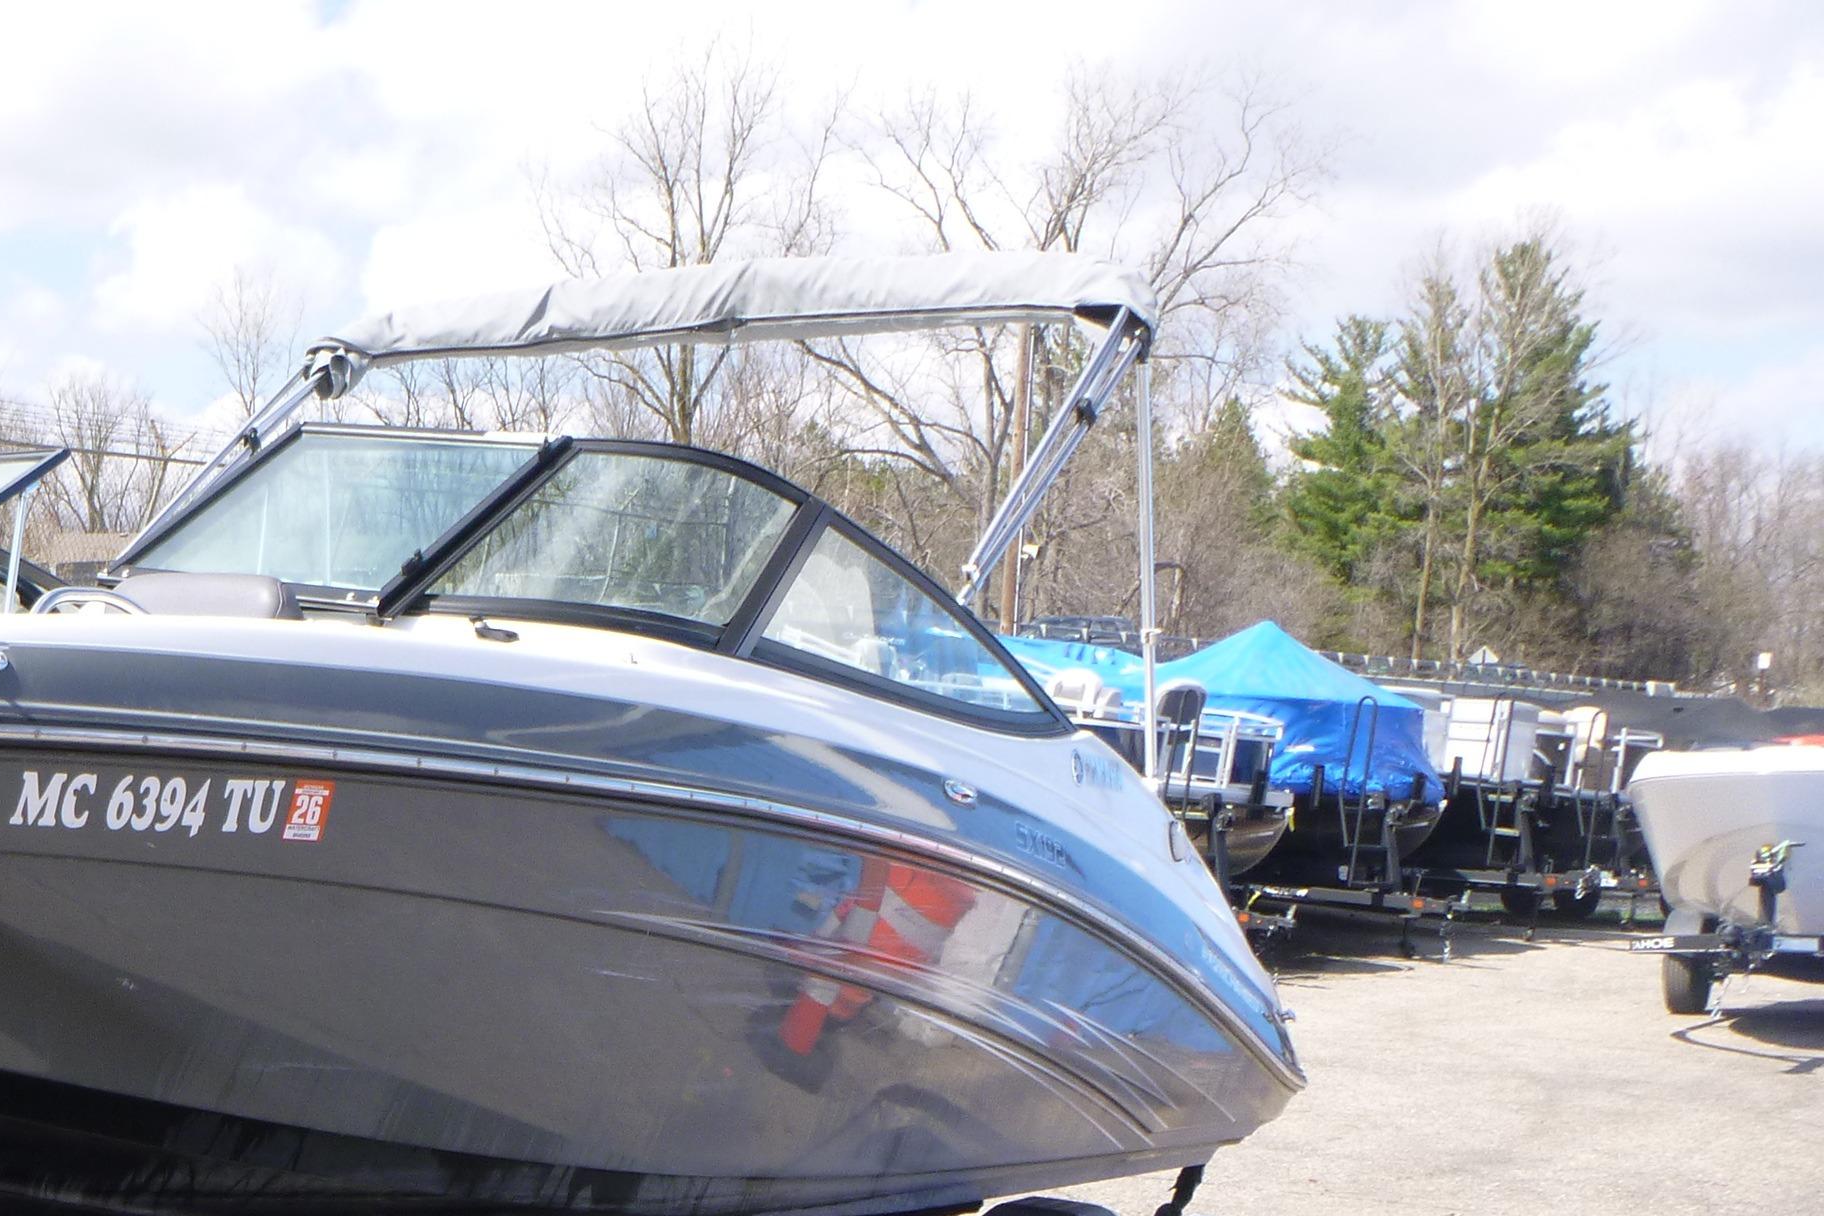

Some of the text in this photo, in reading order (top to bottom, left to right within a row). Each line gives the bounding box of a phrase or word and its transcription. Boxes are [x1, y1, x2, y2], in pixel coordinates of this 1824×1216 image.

[9, 771, 286, 838] MC 6394 TU
[292, 796, 323, 824] 26
